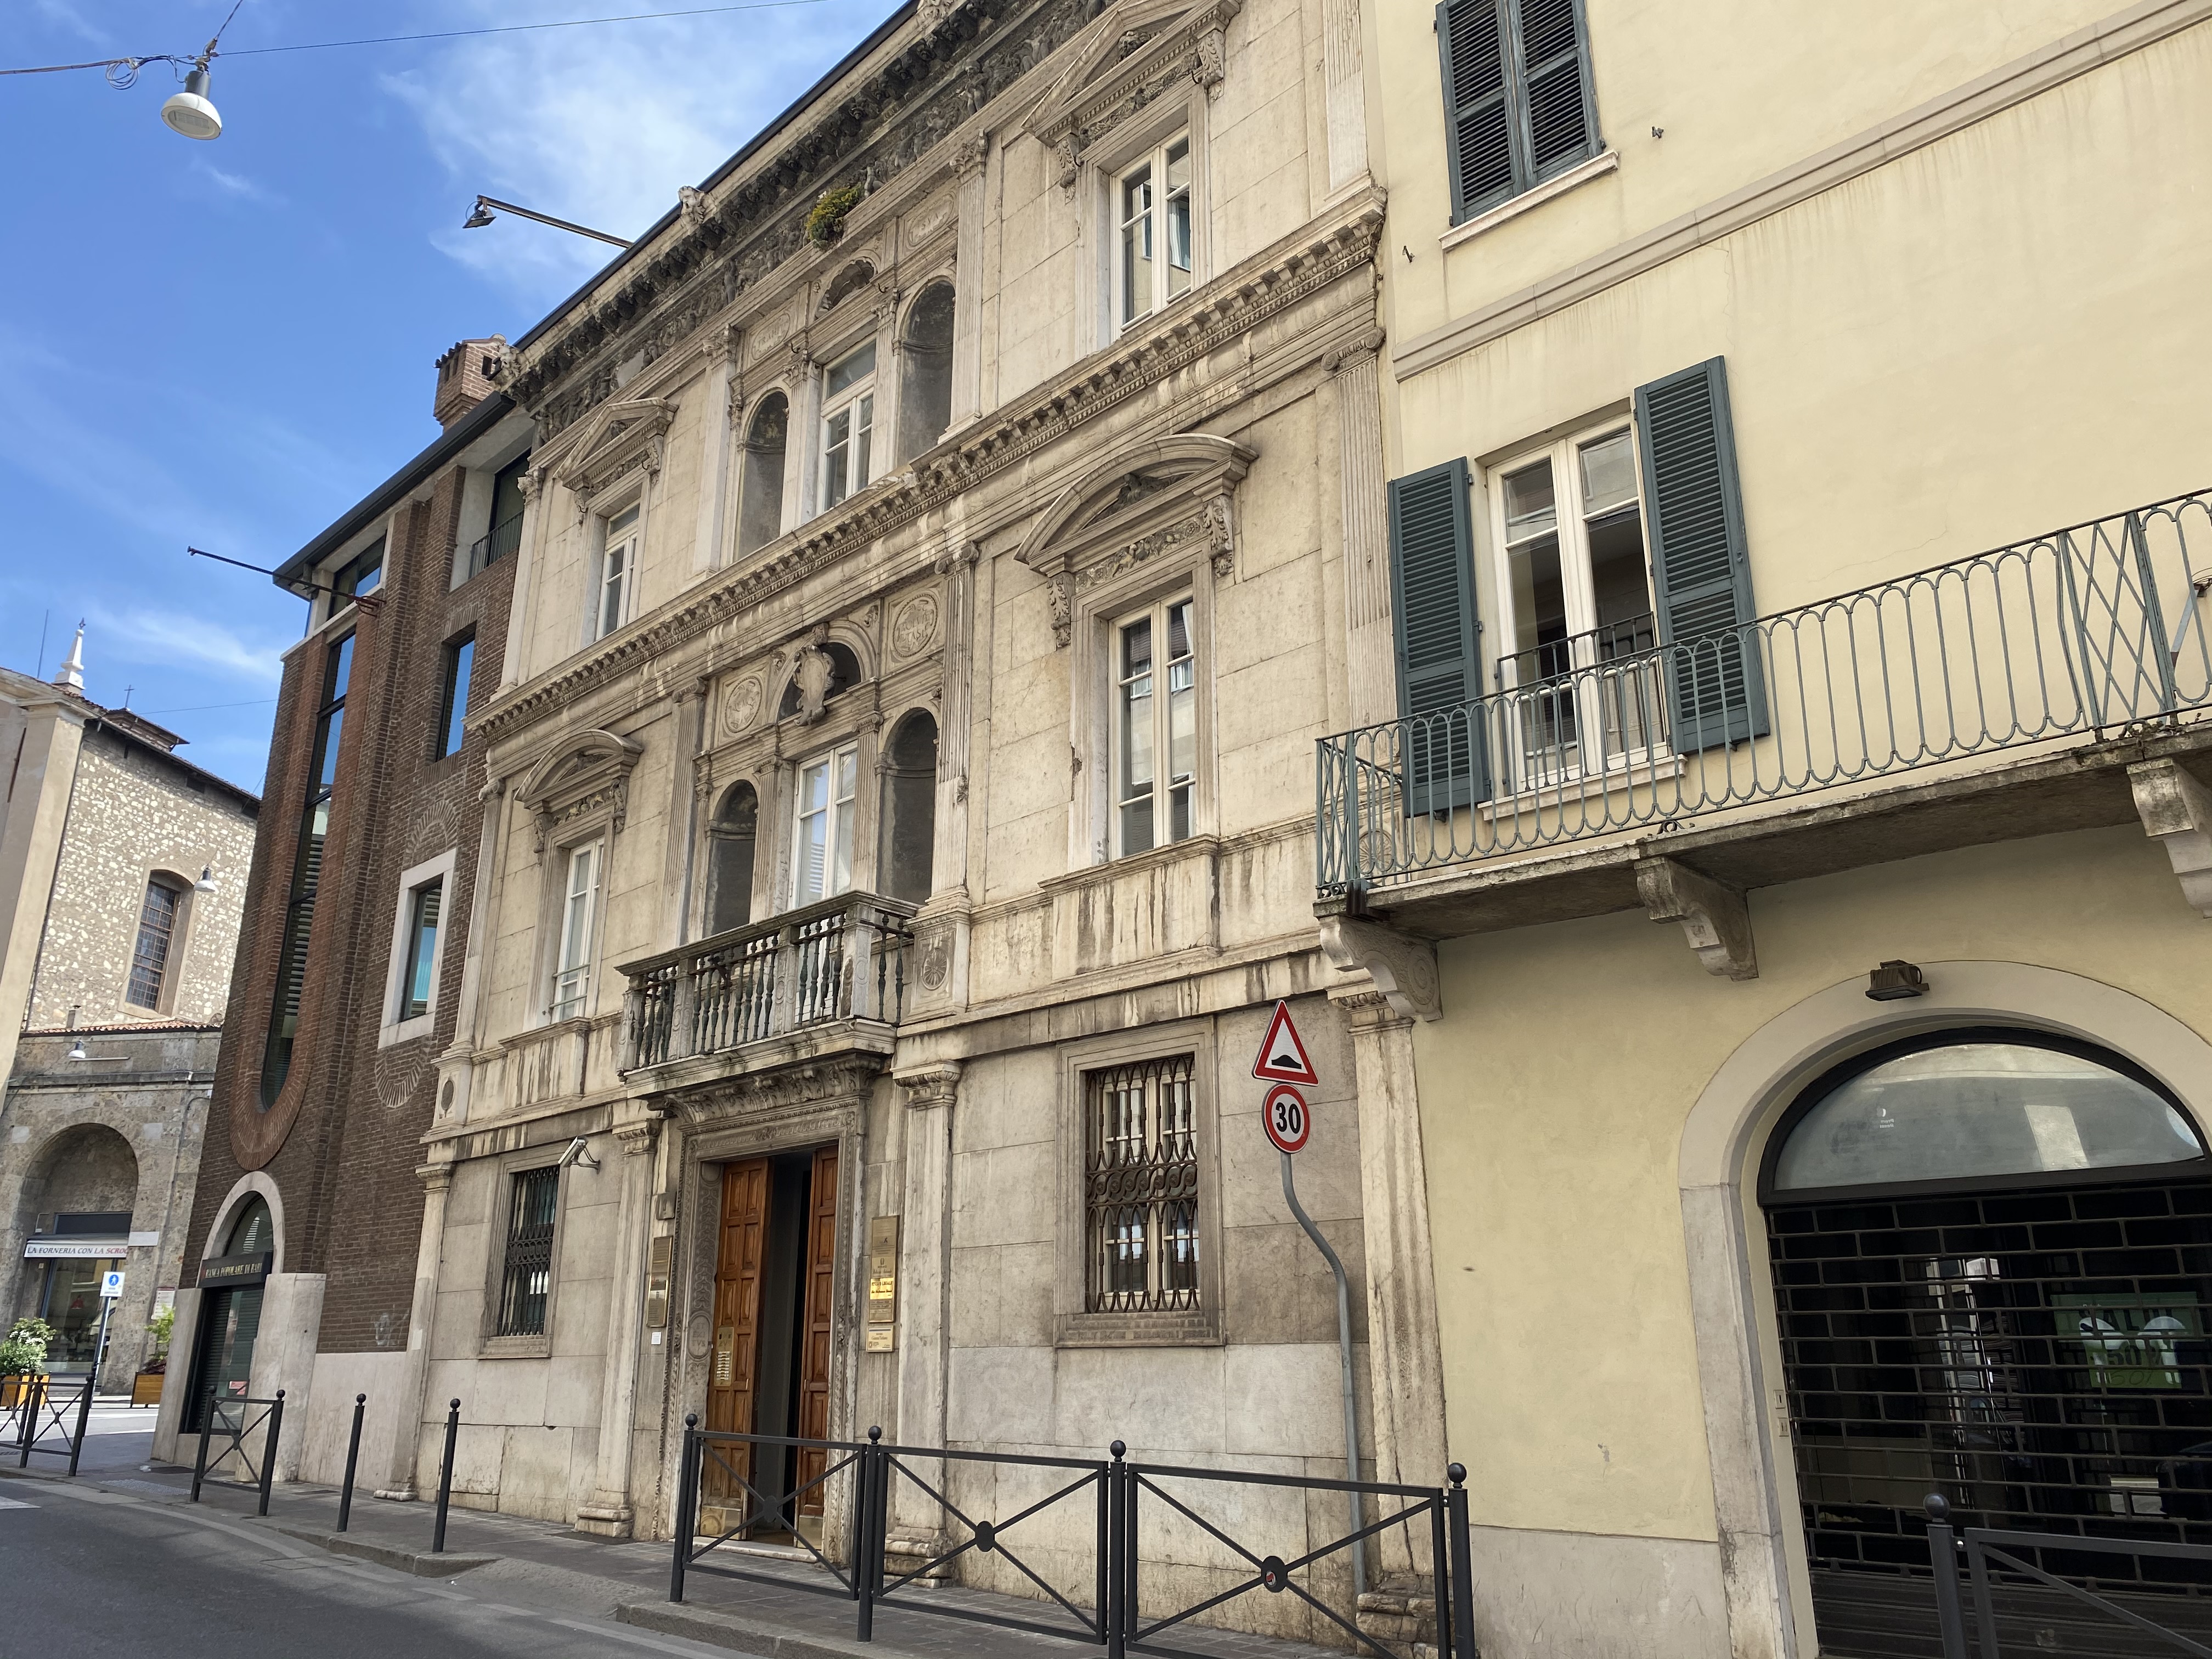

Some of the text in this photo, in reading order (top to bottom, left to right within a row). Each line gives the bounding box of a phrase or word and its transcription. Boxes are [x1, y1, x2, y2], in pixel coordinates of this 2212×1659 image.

[1276, 1102, 1301, 1134] 30
[205, 1262, 263, 1278] BANCA POPOLARE DI BARI
